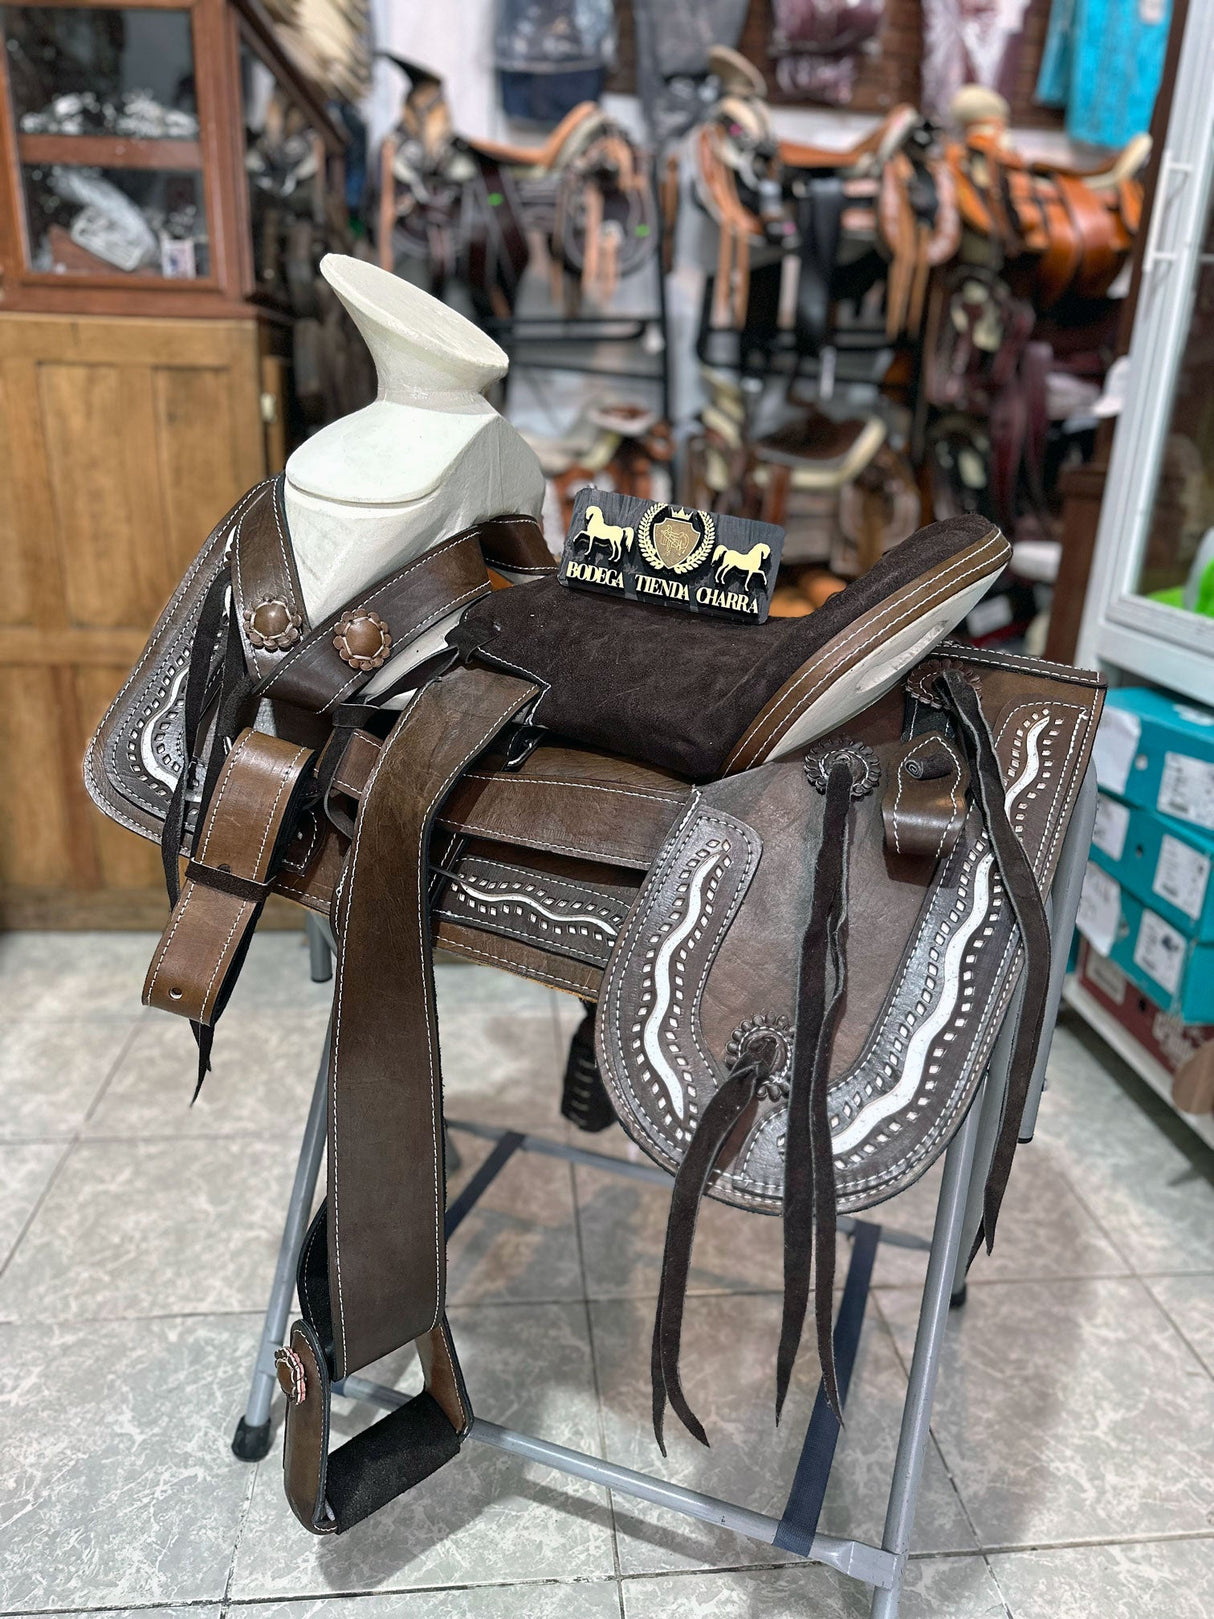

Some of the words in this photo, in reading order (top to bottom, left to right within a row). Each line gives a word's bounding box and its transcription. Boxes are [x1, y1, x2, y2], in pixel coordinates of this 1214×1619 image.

[567, 562, 624, 588] BODEGA
[635, 575, 689, 600] TIENDA
[697, 588, 758, 614] CHARRA
